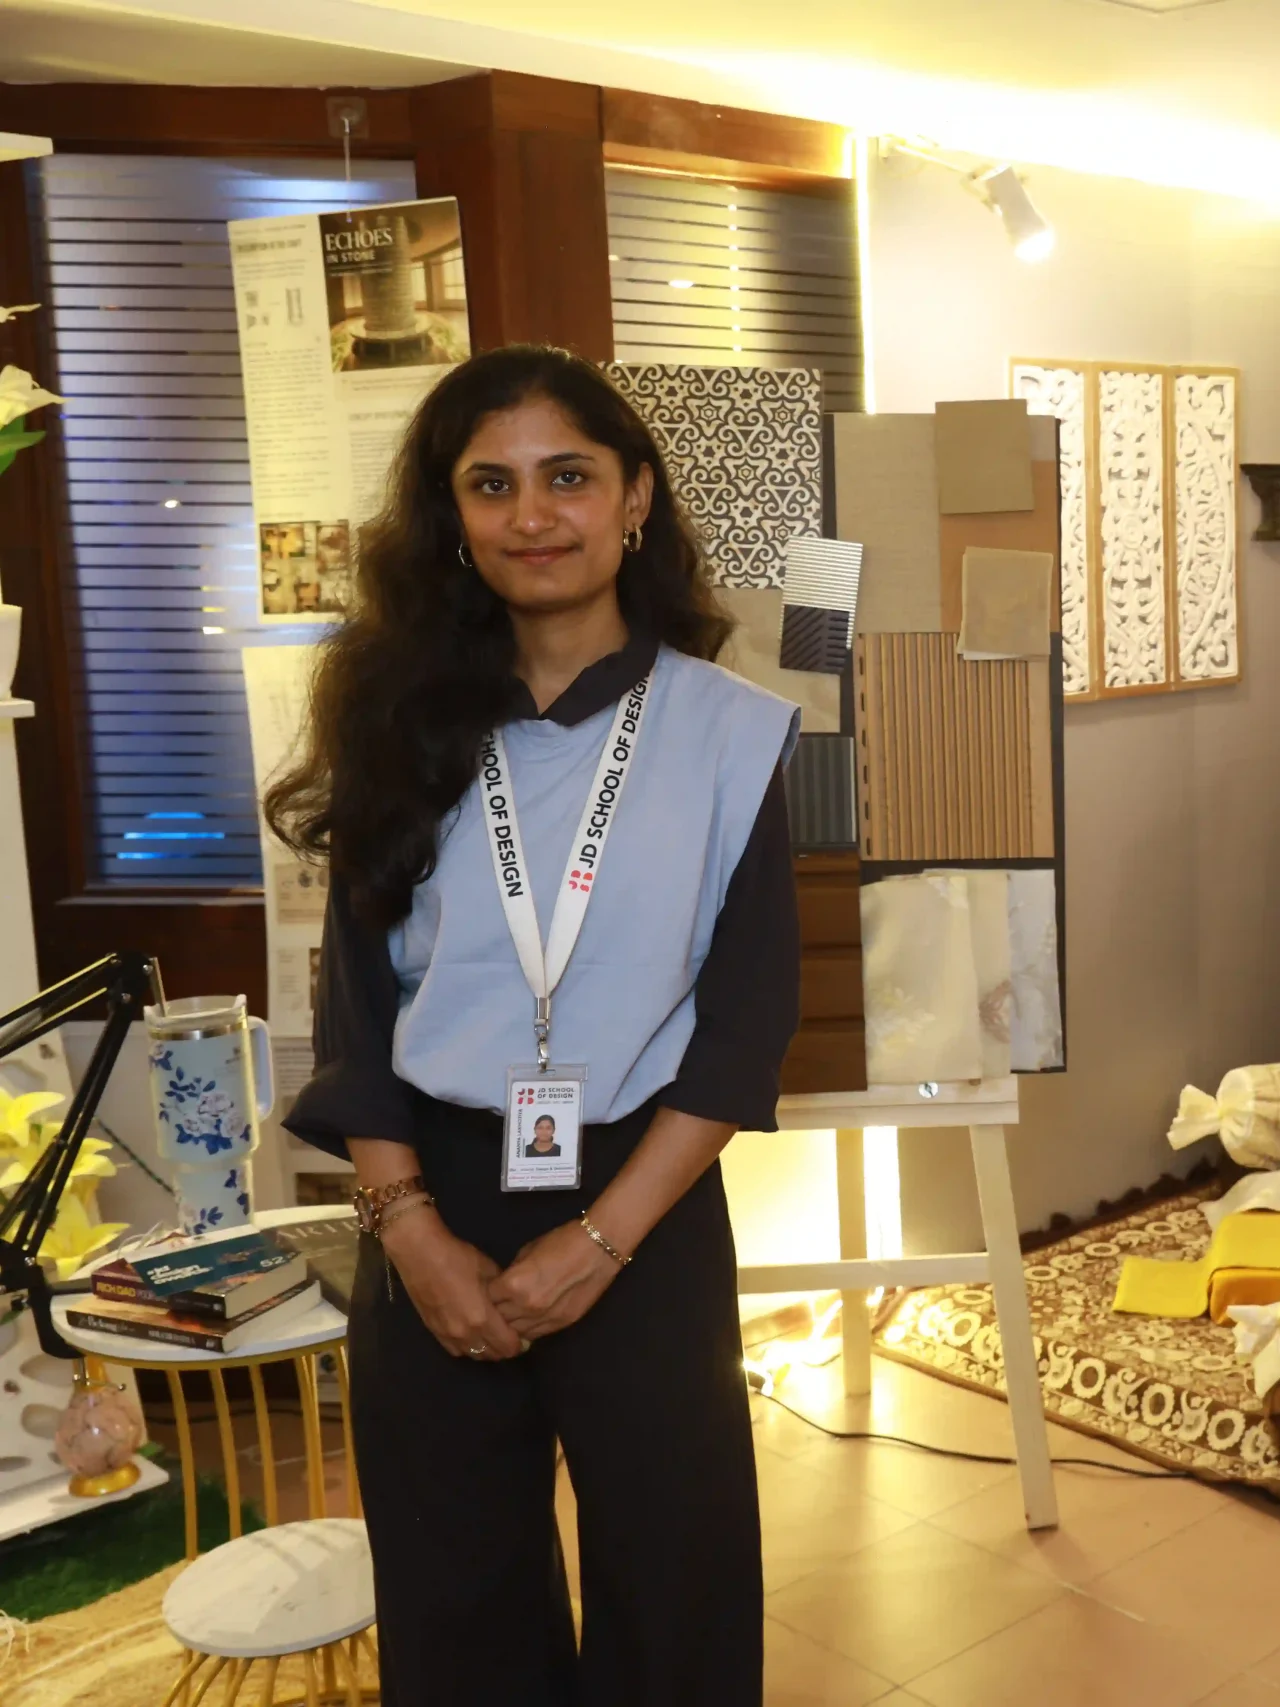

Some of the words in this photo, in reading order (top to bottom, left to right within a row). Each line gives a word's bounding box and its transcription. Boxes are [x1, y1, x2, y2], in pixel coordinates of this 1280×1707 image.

[325, 227, 393, 251] ECHOES
[326, 254, 339, 264] IN
[341, 249, 375, 263] STONE
[482, 731, 502, 792] HOOL
[612, 736, 631, 762] OF
[489, 795, 508, 820] OF
[587, 767, 624, 839] SCHOOL
[494, 825, 524, 898] DESIGN
[578, 843, 598, 868] JD
[95, 1281, 116, 1293] RICH
[117, 1285, 136, 1297] DAD
